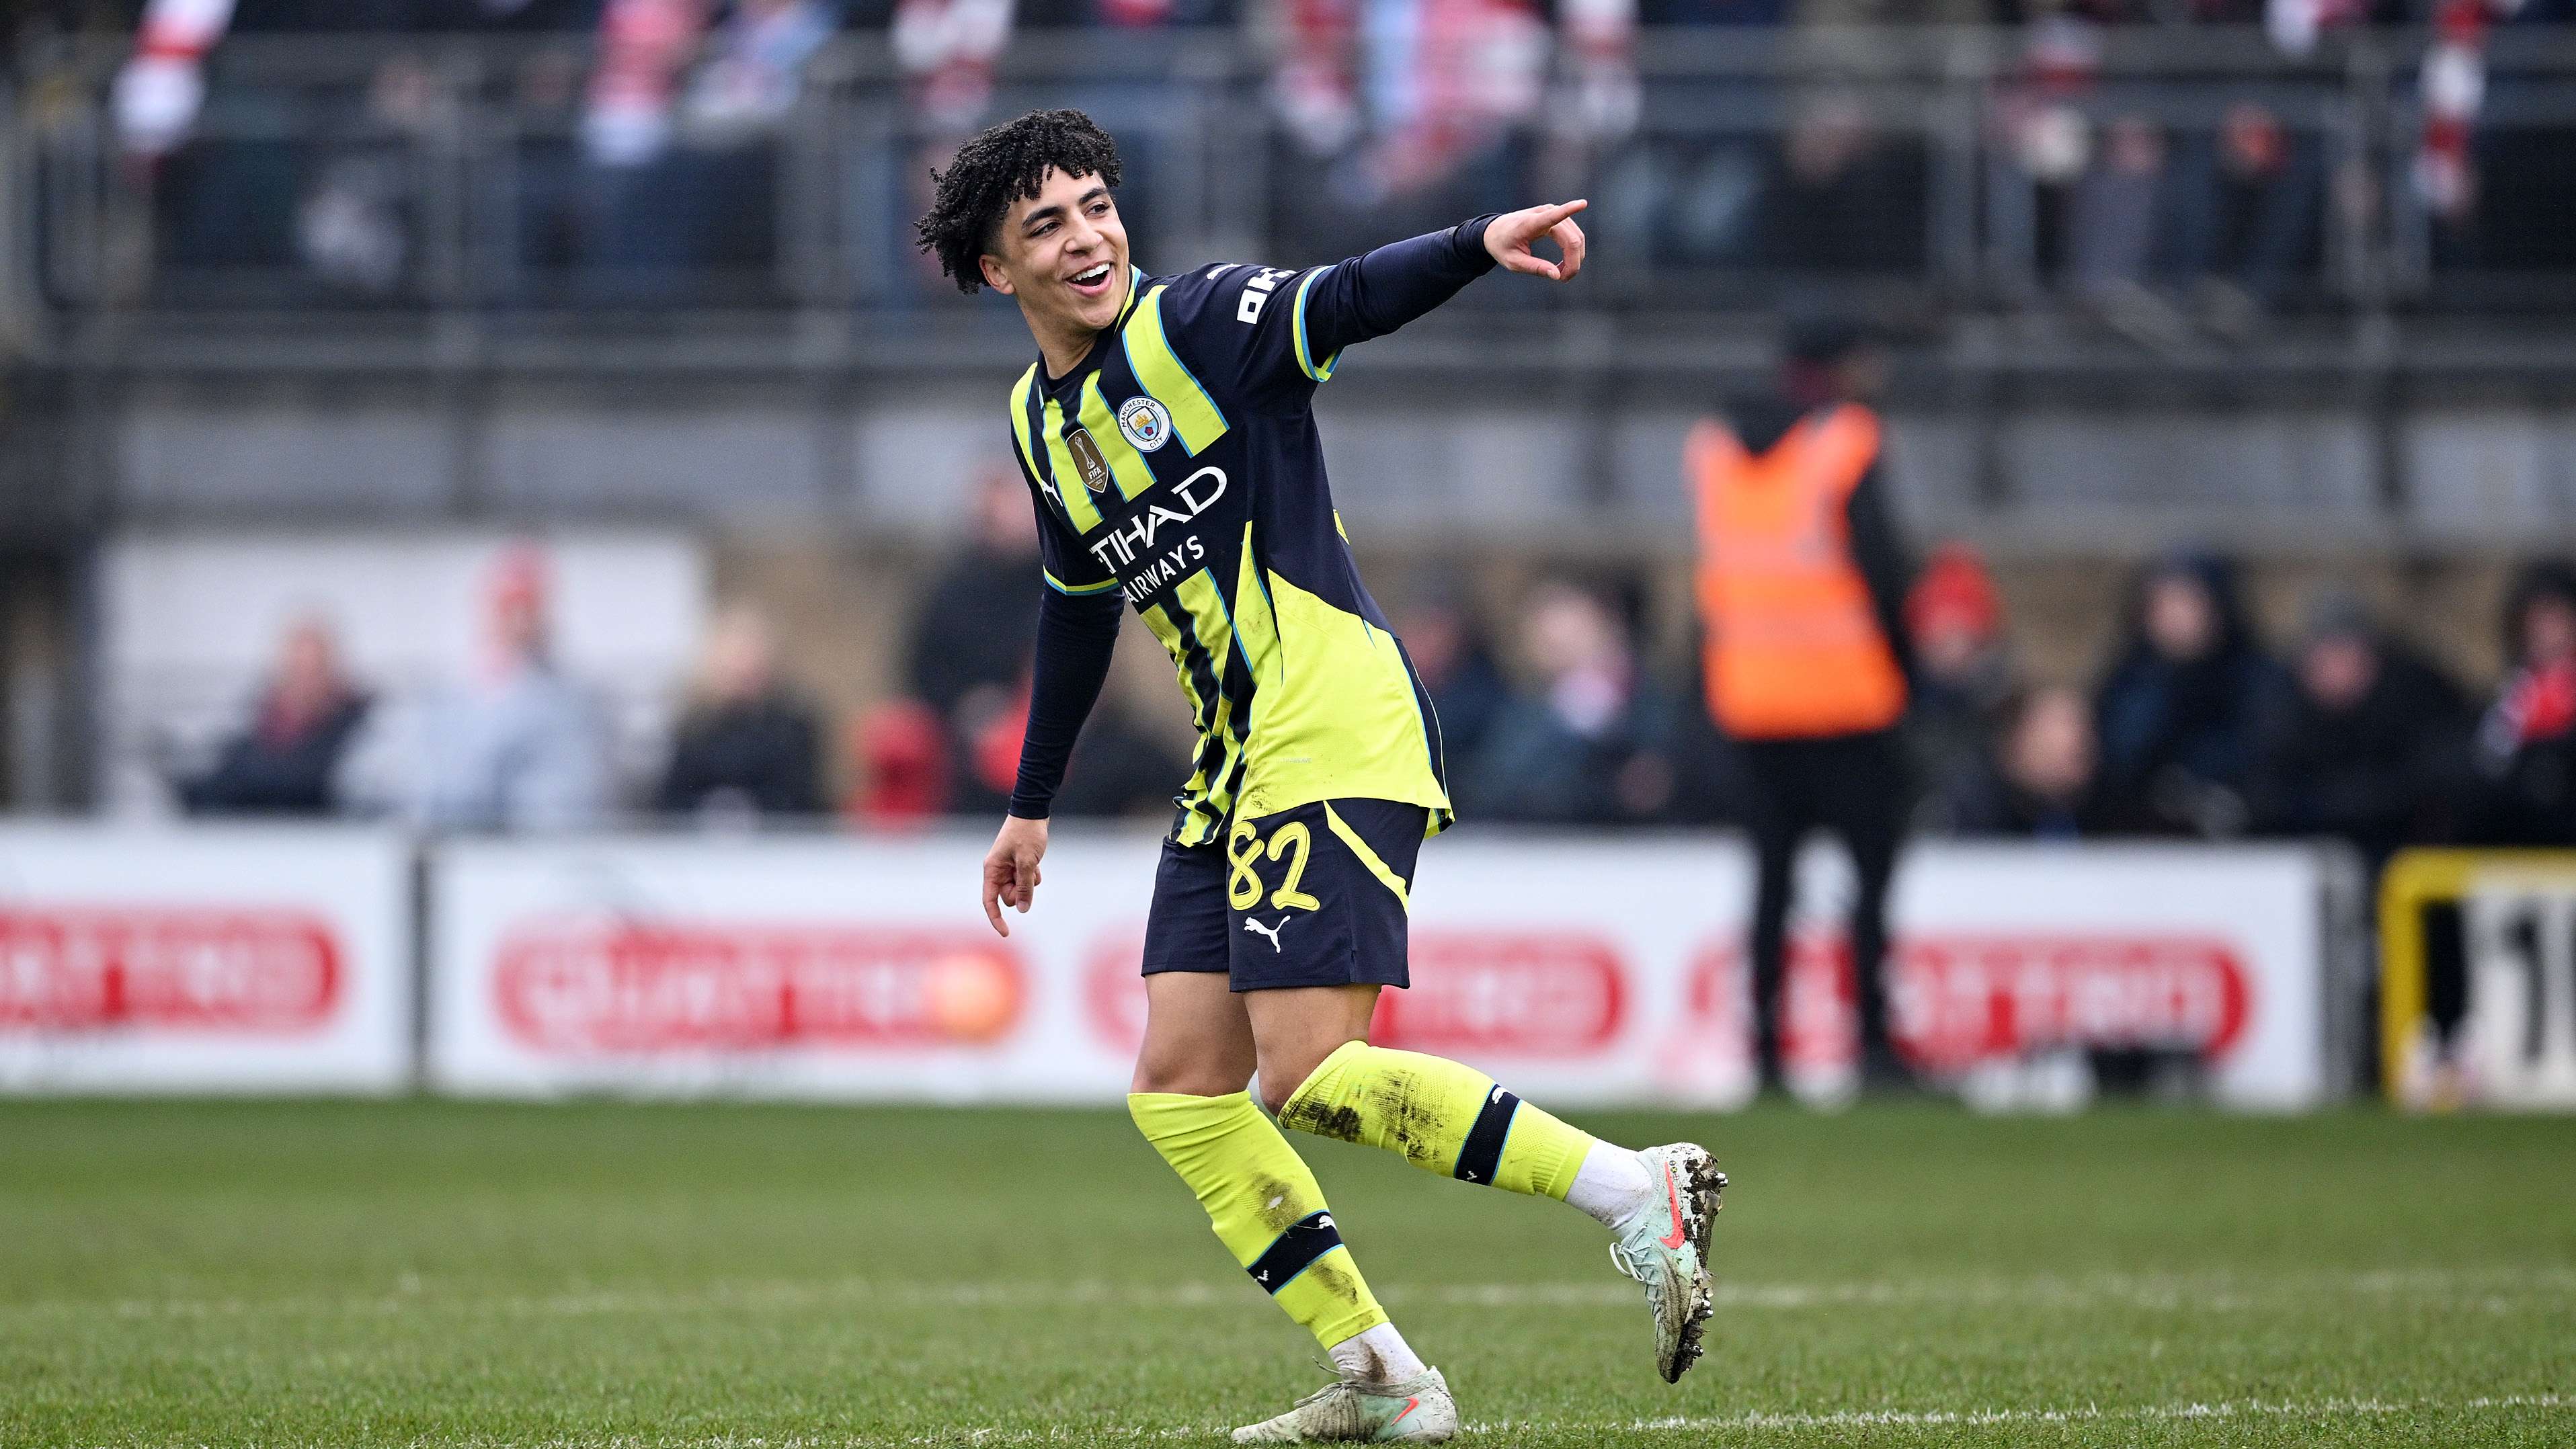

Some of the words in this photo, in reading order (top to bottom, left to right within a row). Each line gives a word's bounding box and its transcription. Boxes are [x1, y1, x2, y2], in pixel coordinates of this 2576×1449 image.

[1237, 267, 1297, 325] OK
[1121, 399, 1156, 428] MANCHESTER
[1150, 436, 1163, 448] CITY
[1088, 466, 1102, 480] FIFA
[1089, 466, 1227, 575] TIHAD
[1123, 535, 1205, 603] AIRWAYS
[1229, 821, 1320, 911] 82
